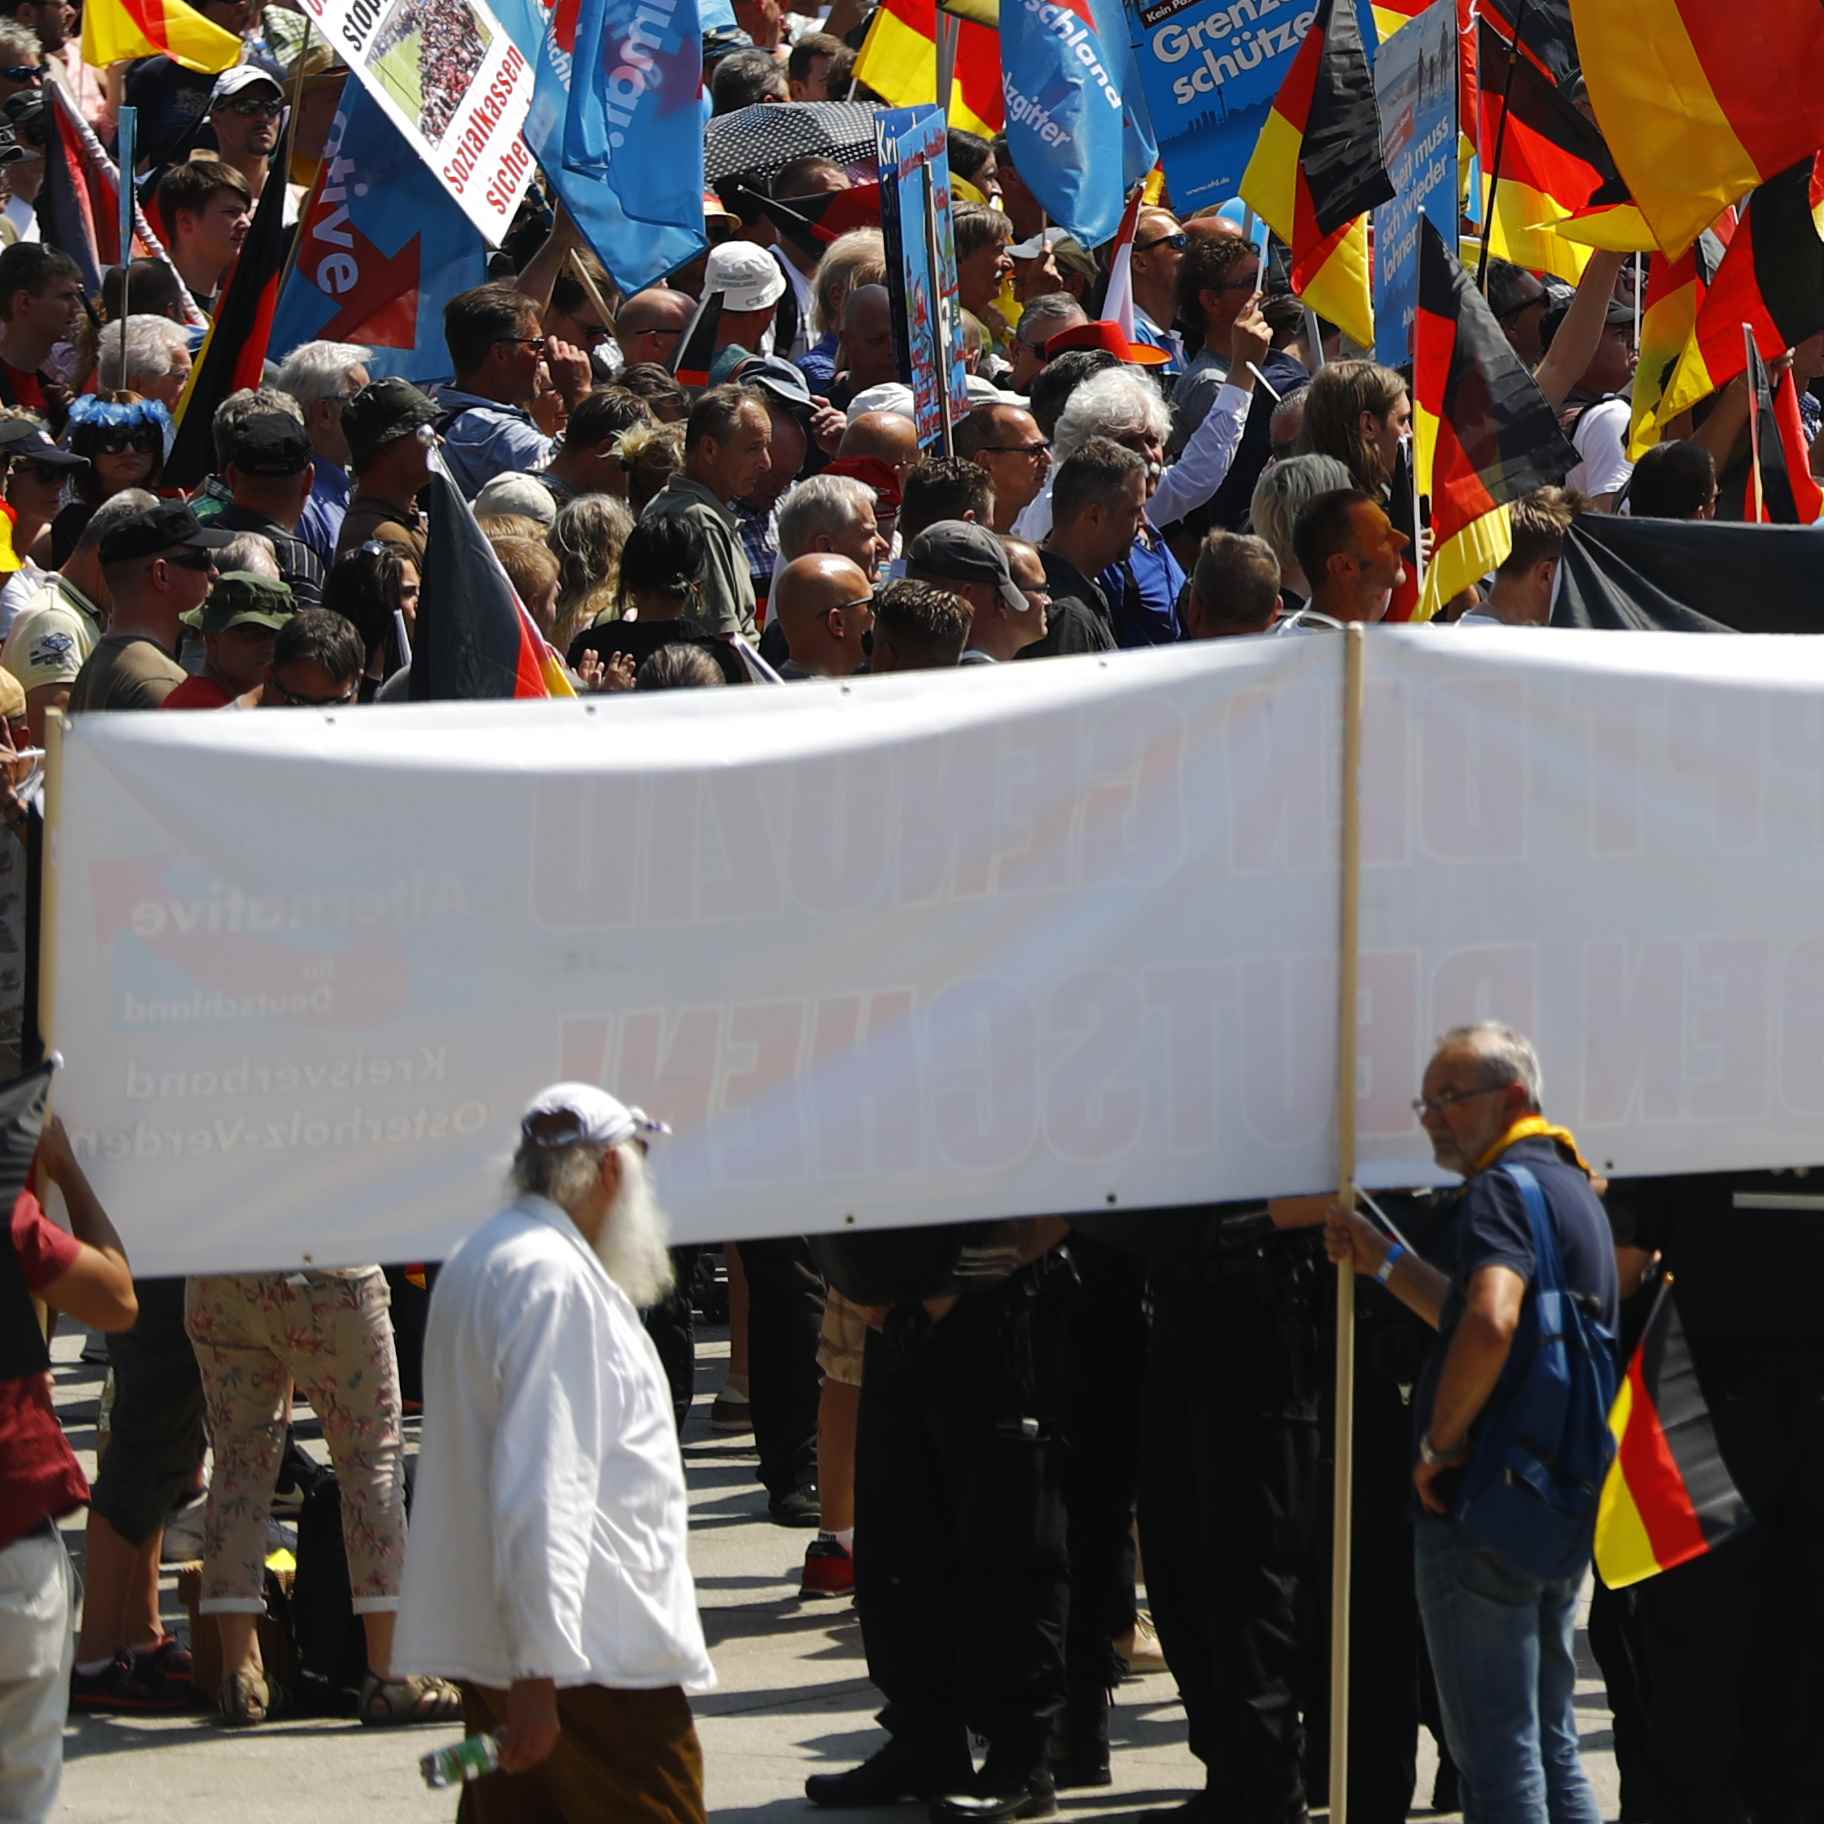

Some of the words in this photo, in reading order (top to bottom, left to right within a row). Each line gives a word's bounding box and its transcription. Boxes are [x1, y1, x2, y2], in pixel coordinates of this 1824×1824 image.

[1146, 2, 1172, 24] Kein
[1172, 9, 1320, 106] schütze
[442, 43, 526, 197] Sozialkassen
